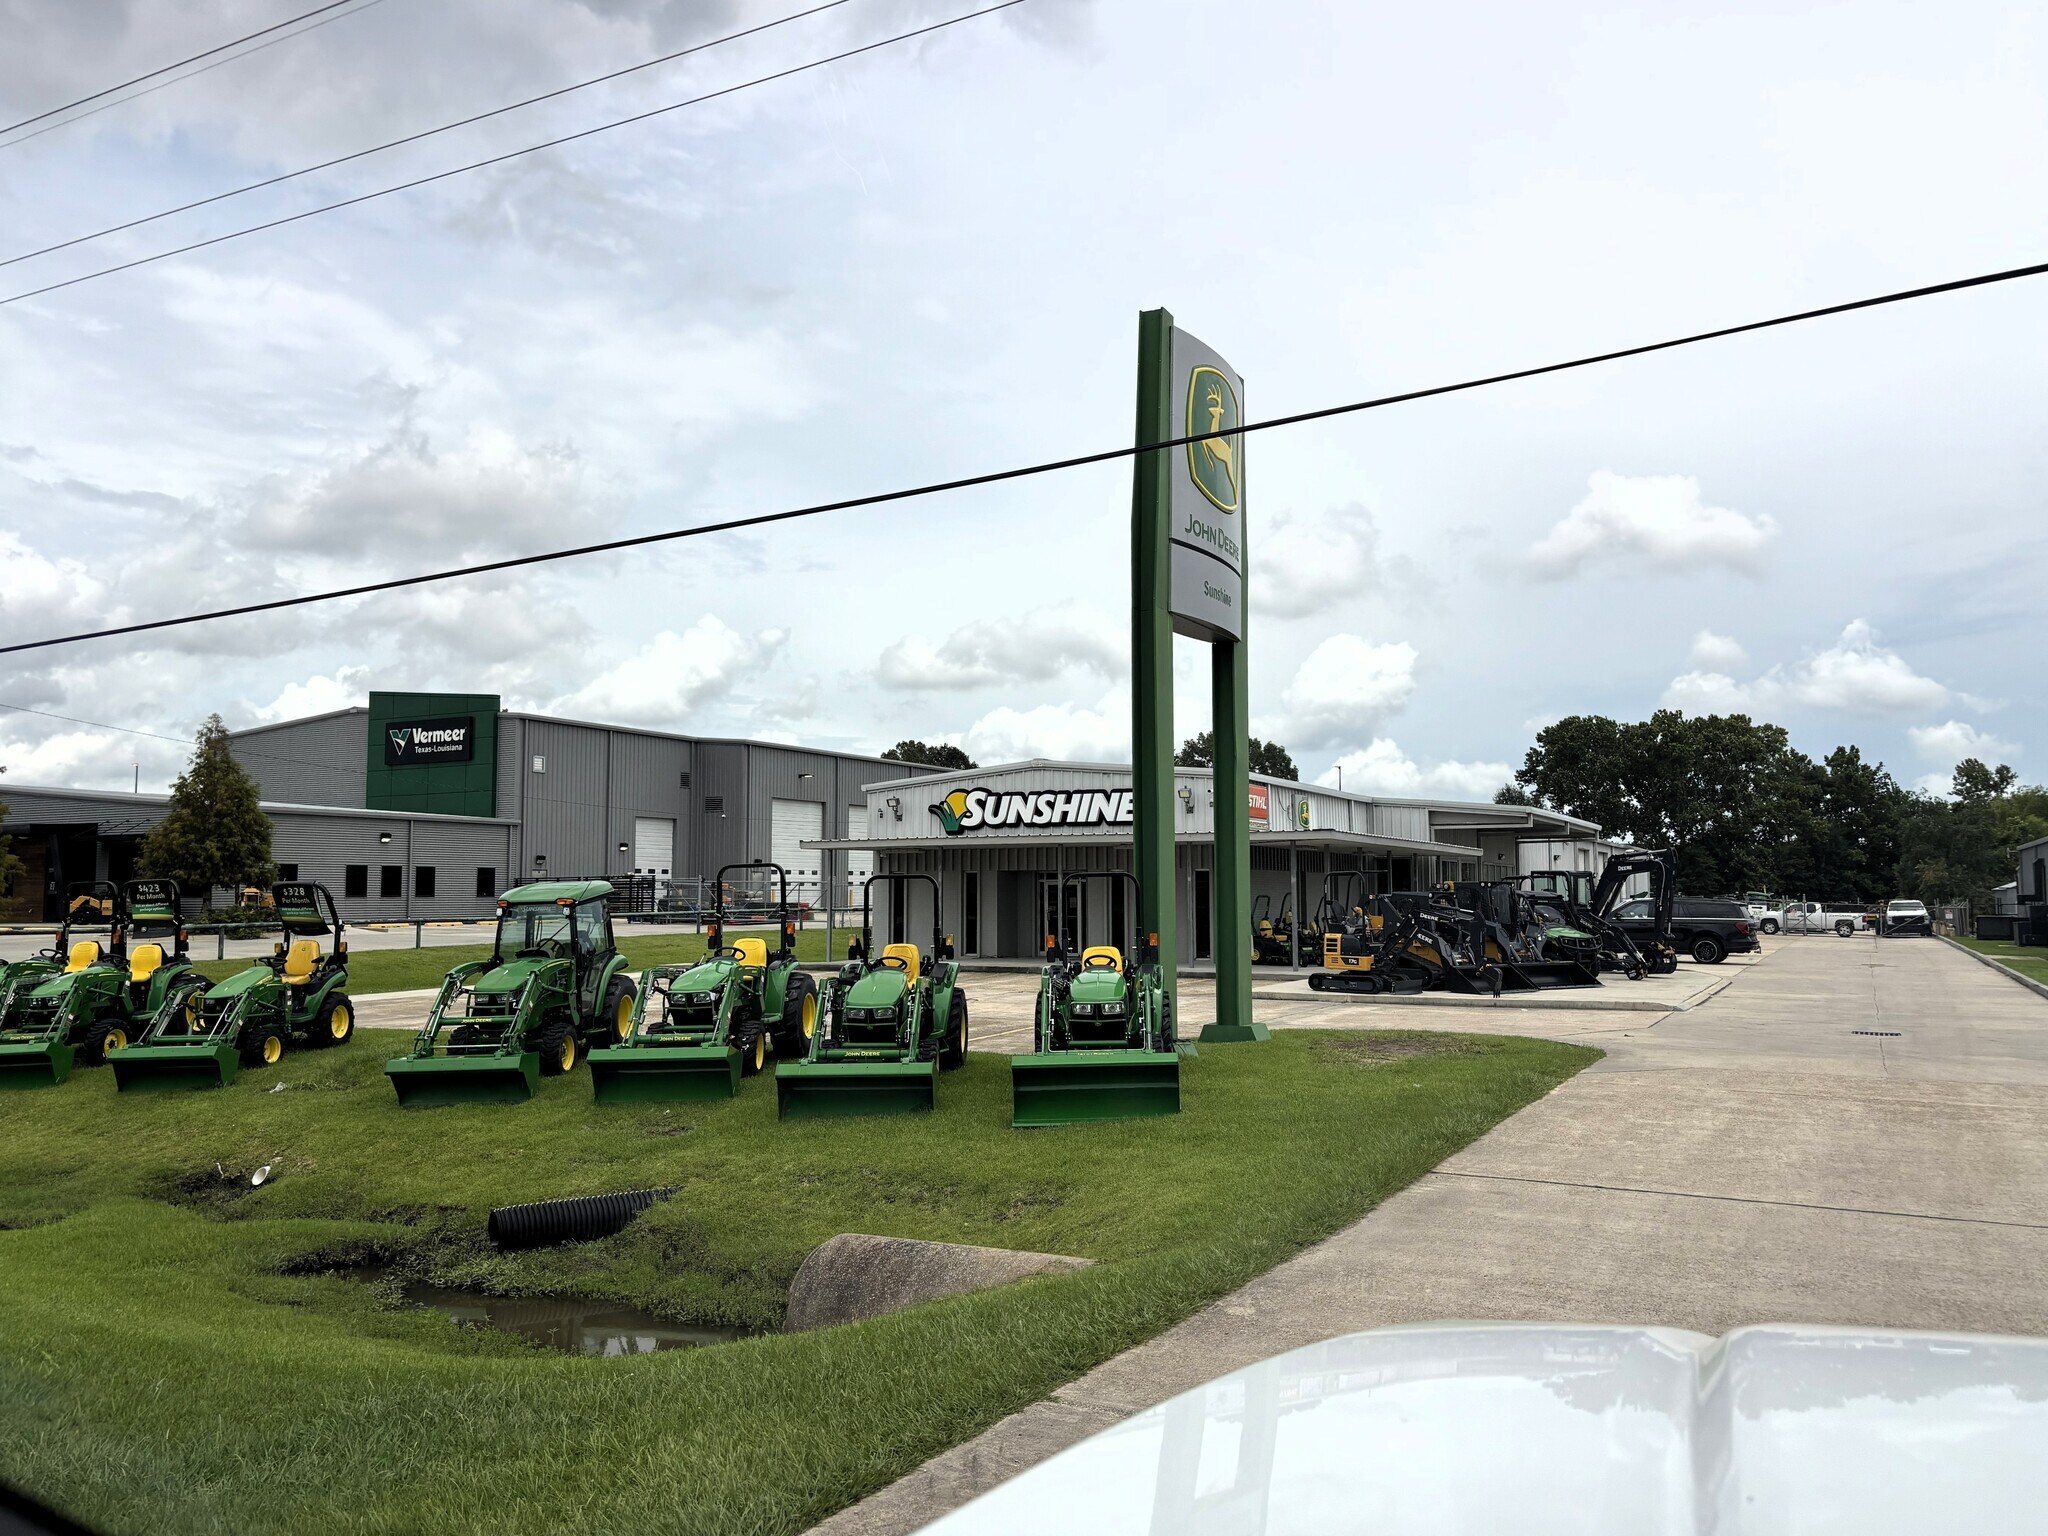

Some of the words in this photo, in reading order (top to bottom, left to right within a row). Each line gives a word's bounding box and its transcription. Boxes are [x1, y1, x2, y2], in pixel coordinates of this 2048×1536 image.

[1184, 513, 1217, 546] JOHN
[1217, 527, 1240, 563] DEERE
[1203, 580, 1232, 607] Sunshine
[412, 727, 466, 744] Vermeer
[414, 743, 463, 754] Texas-Louisiana
[1248, 794, 1268, 810] STIHL
[959, 790, 1134, 828] SUNSHINE
[138, 884, 160, 893] $423
[282, 887, 306, 896] $328
[146, 892, 166, 900] Month
[1420, 912, 1439, 921] DEERE
